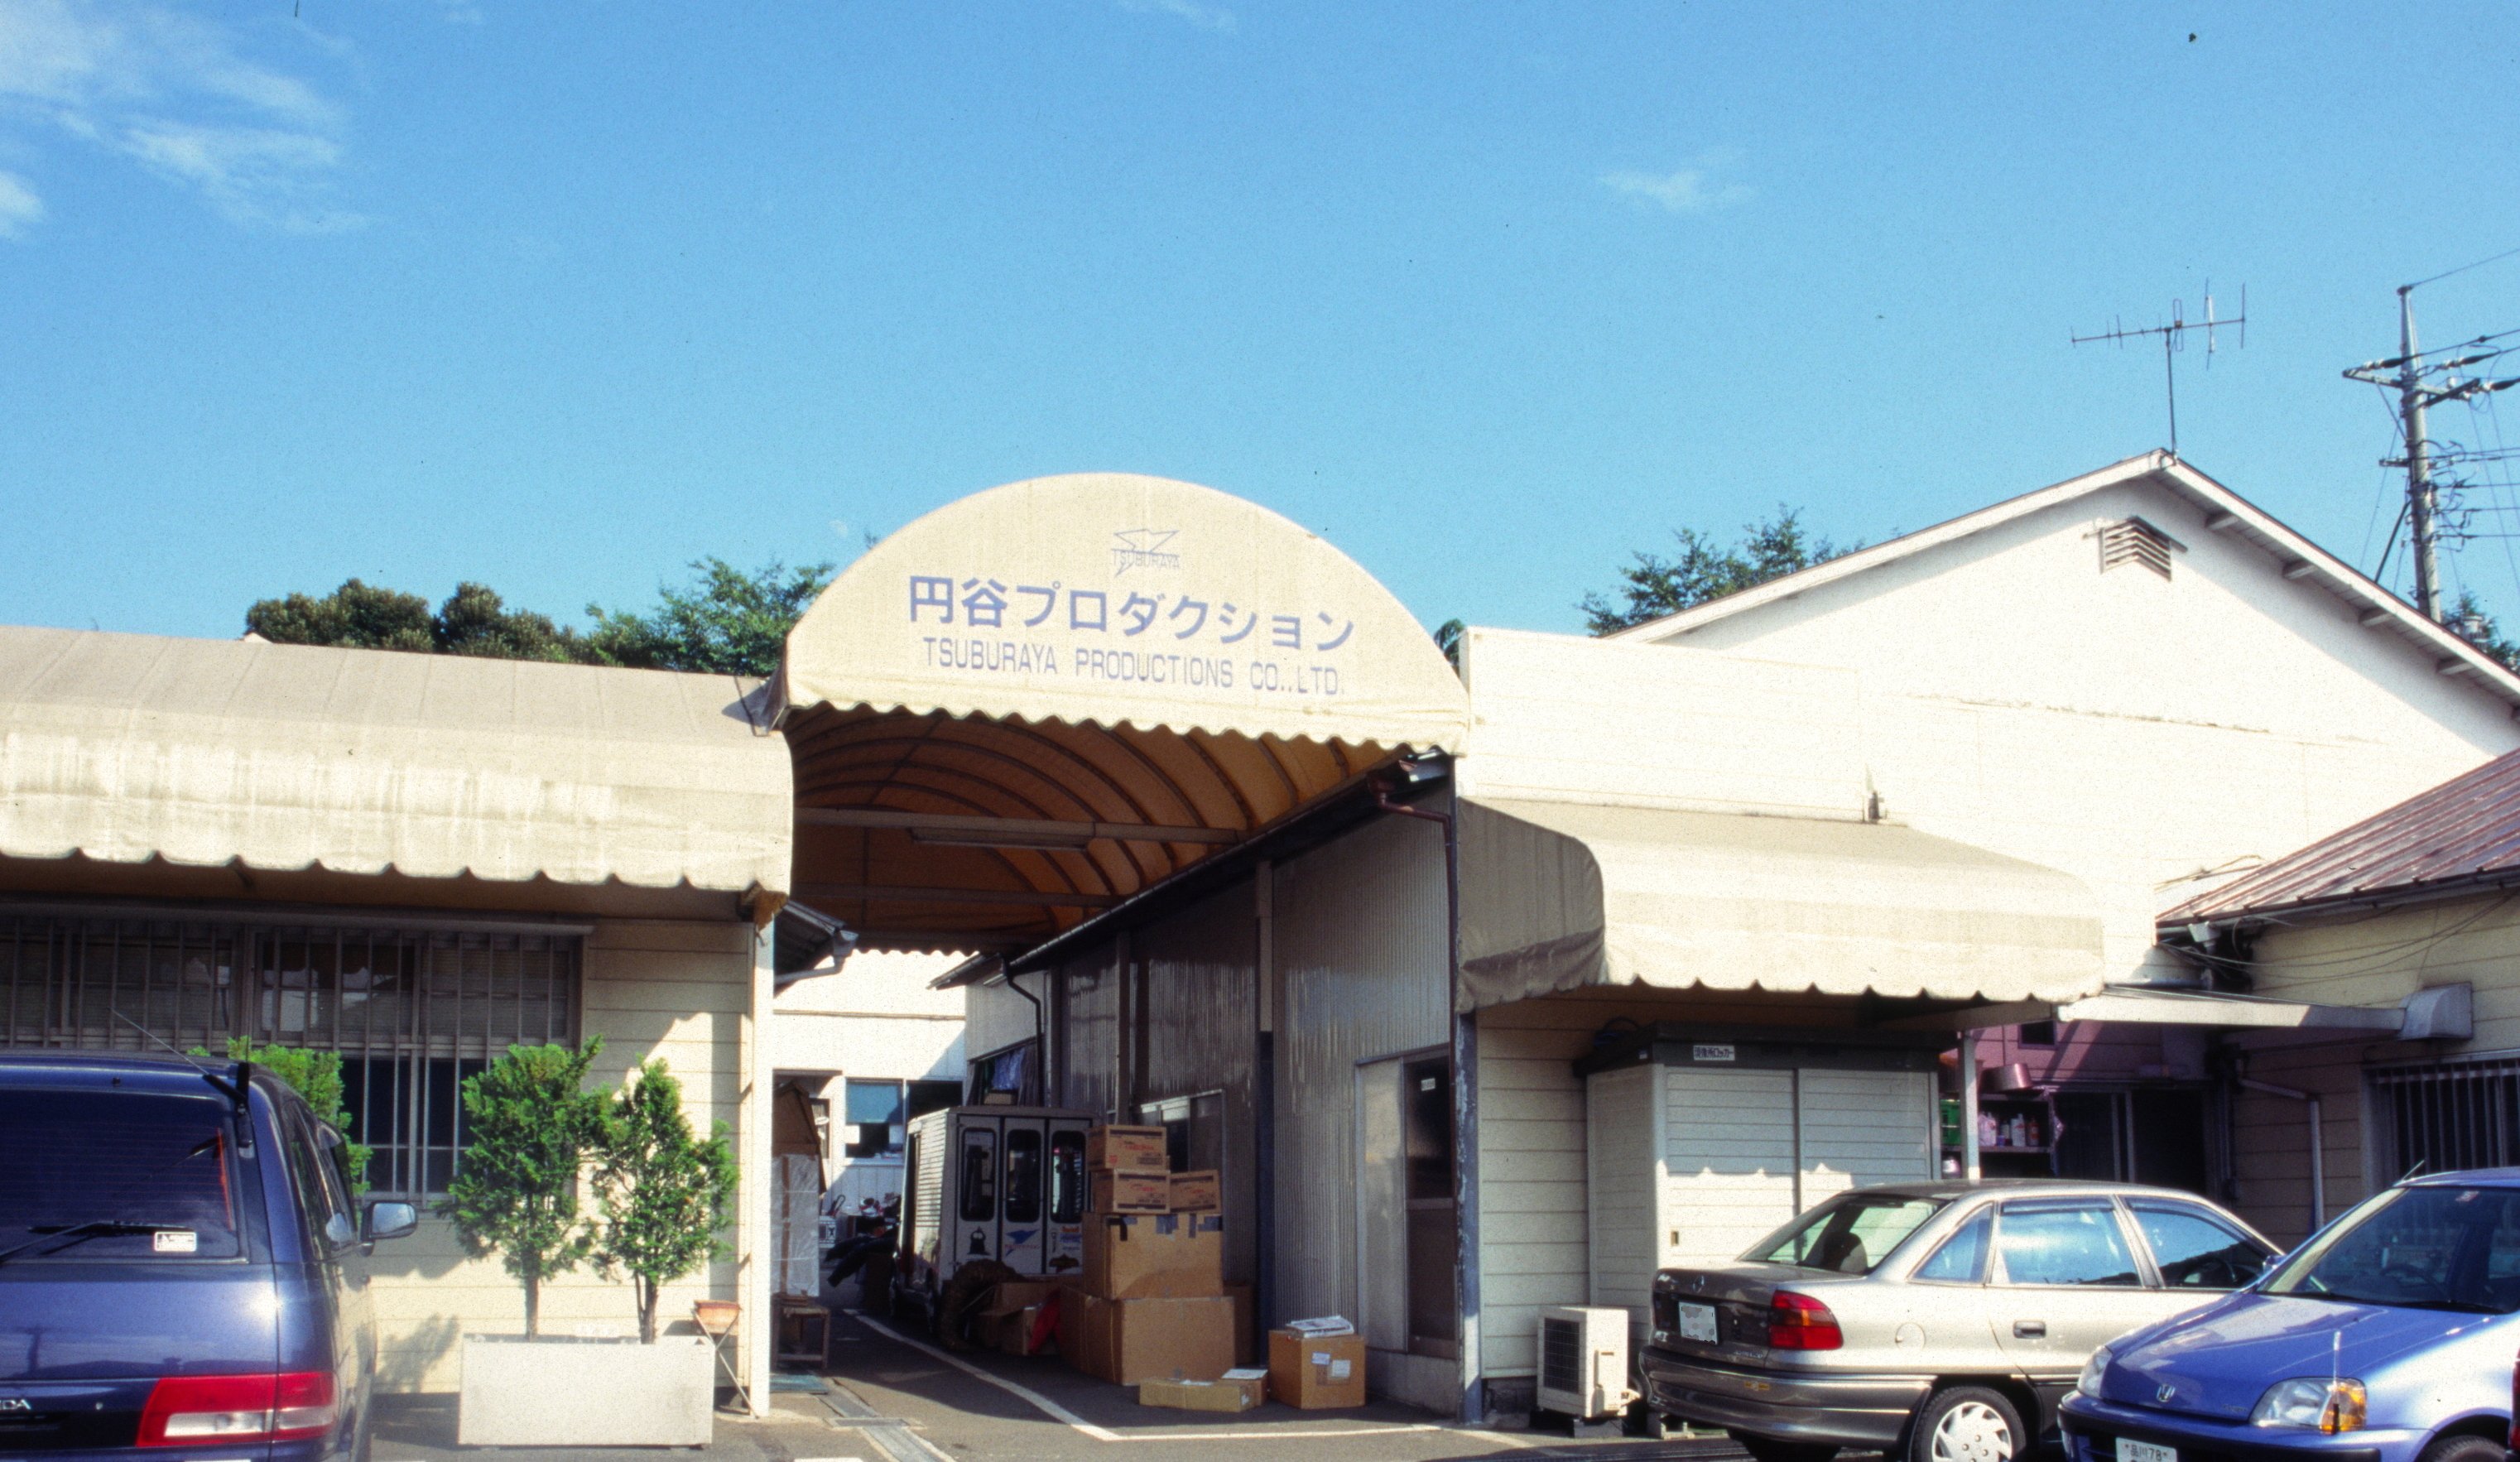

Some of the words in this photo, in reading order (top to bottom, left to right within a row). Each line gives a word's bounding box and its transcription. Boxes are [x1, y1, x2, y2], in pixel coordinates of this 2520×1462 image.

[910, 575, 1354, 652] 円谷プロダクション
[923, 637, 1058, 674] TSUBURAYA
[1075, 647, 1234, 689] PRODUCTIONS
